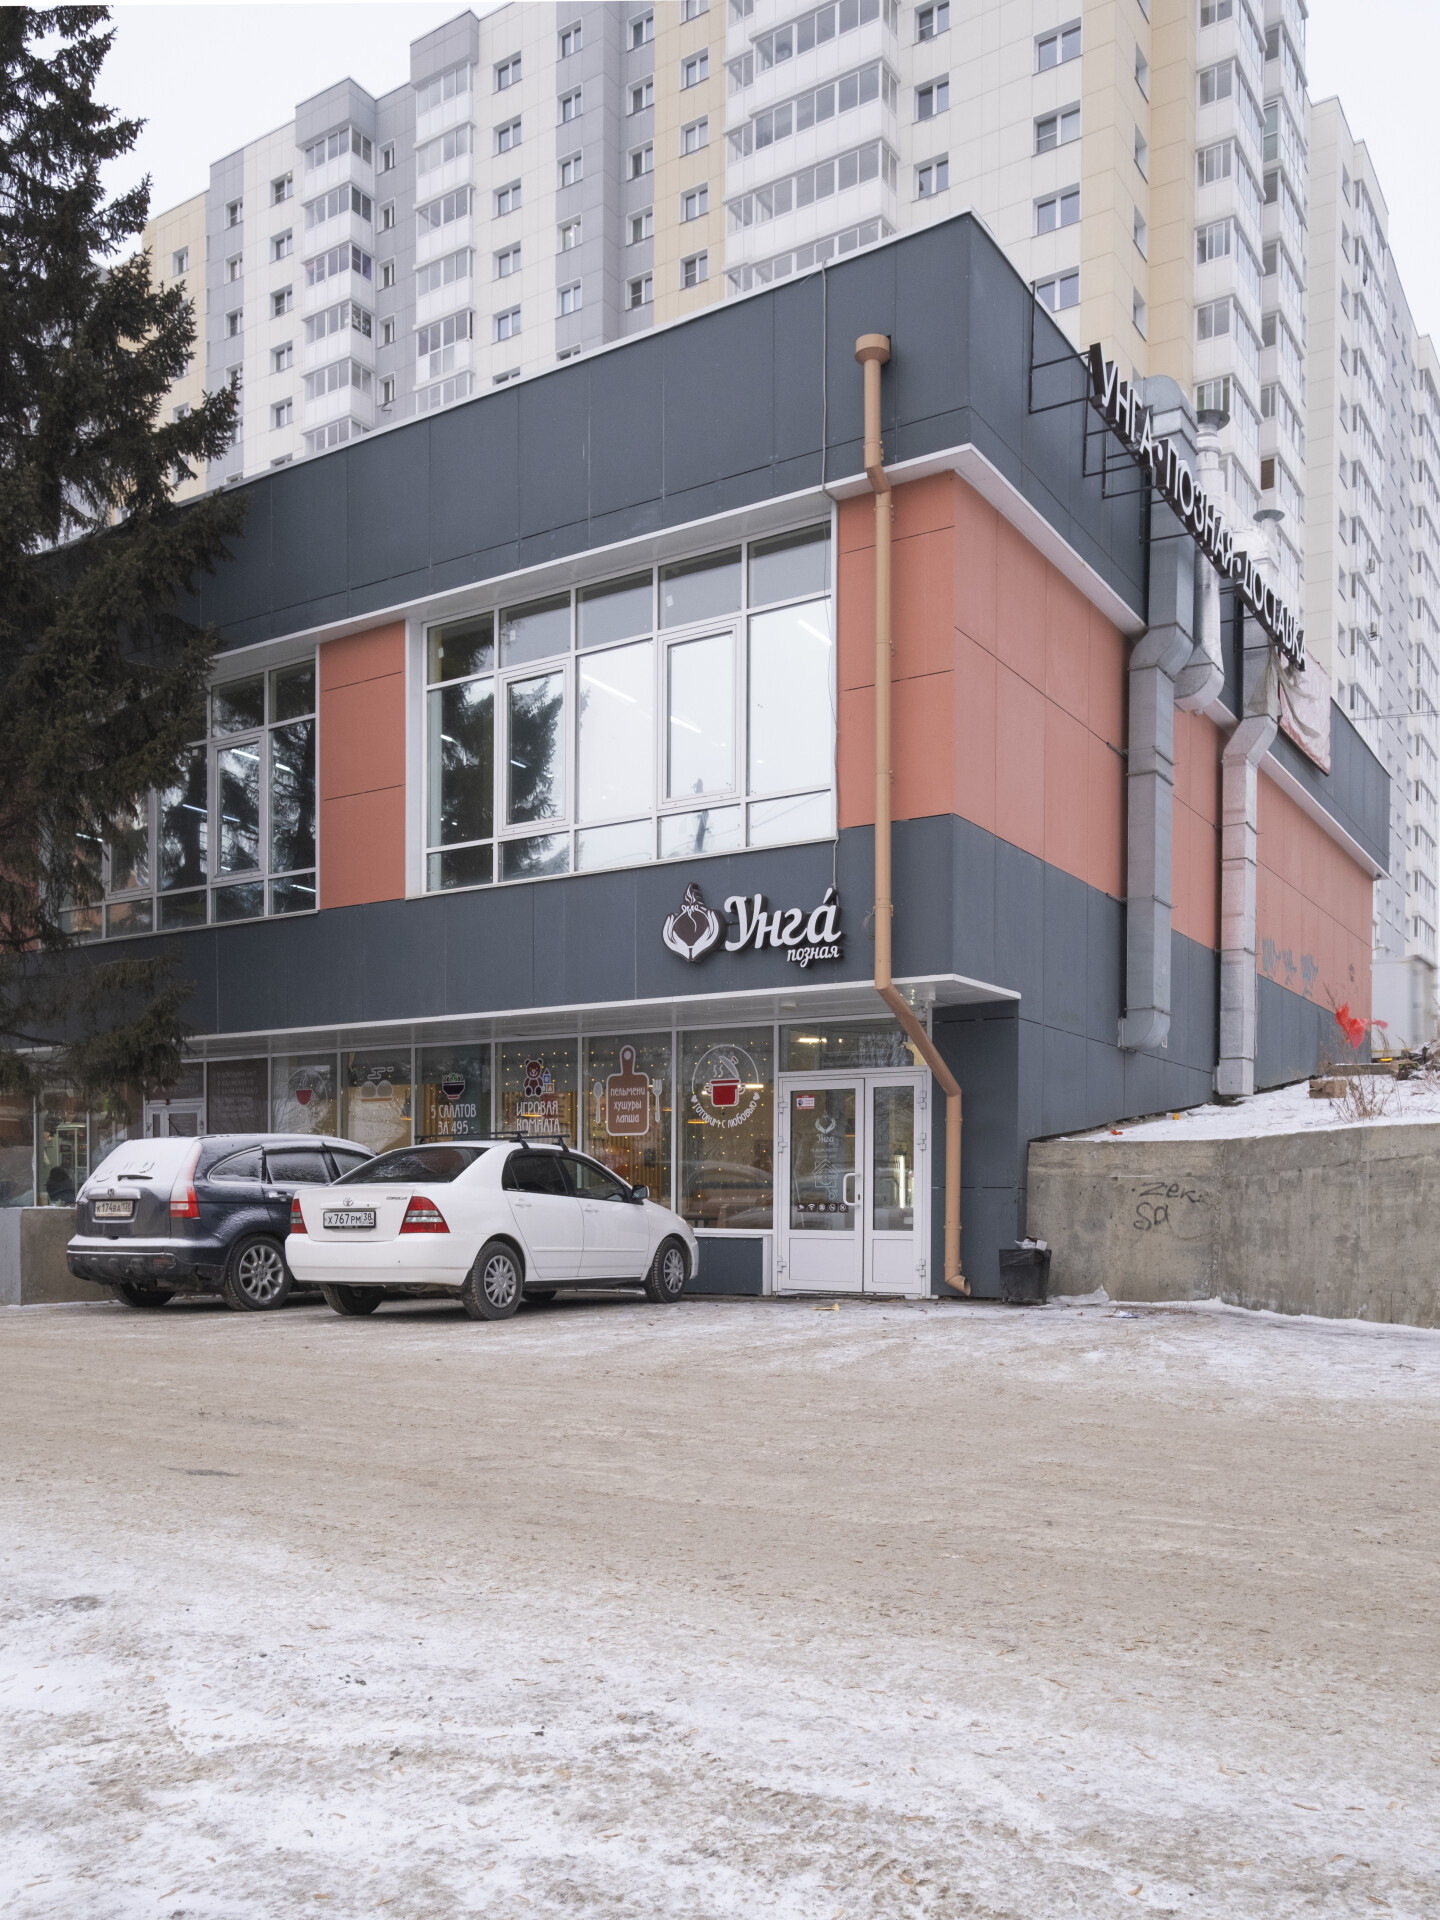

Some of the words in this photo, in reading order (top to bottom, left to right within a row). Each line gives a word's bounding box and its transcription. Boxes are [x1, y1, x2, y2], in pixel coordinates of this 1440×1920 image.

[787, 945, 840, 968] позная
[430, 1105, 436, 1118] 5
[439, 1103, 476, 1118] САЛАТОВ
[516, 1100, 558, 1116] ИГРОВАЯ
[516, 1118, 560, 1133] КОМНАТА
[615, 1114, 640, 1123] лапша
[438, 1121, 448, 1135] ЗА
